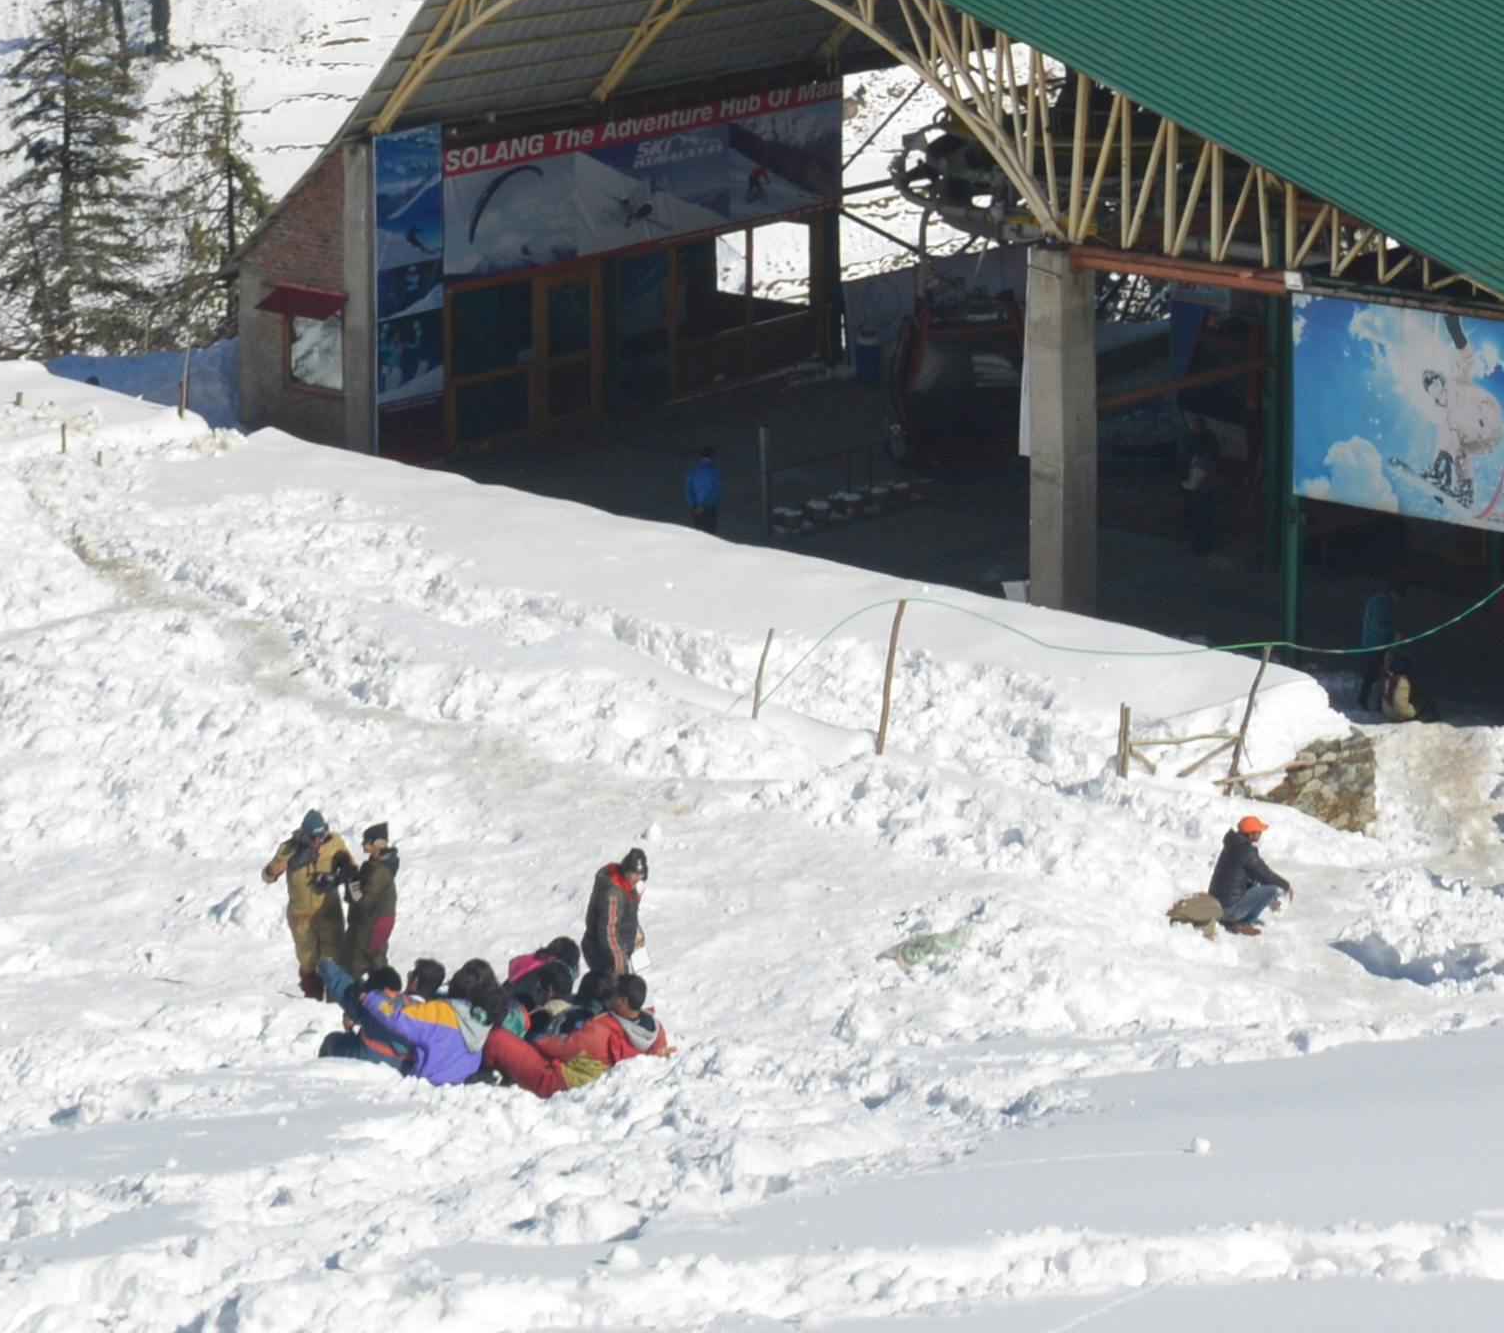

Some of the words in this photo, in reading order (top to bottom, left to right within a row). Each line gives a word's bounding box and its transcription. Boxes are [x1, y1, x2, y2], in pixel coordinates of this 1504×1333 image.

[445, 134, 544, 172] SOLANG
[552, 128, 594, 150] The
[601, 105, 713, 141] Adventure
[720, 93, 761, 118] Hub
[637, 139, 672, 159] SKI
